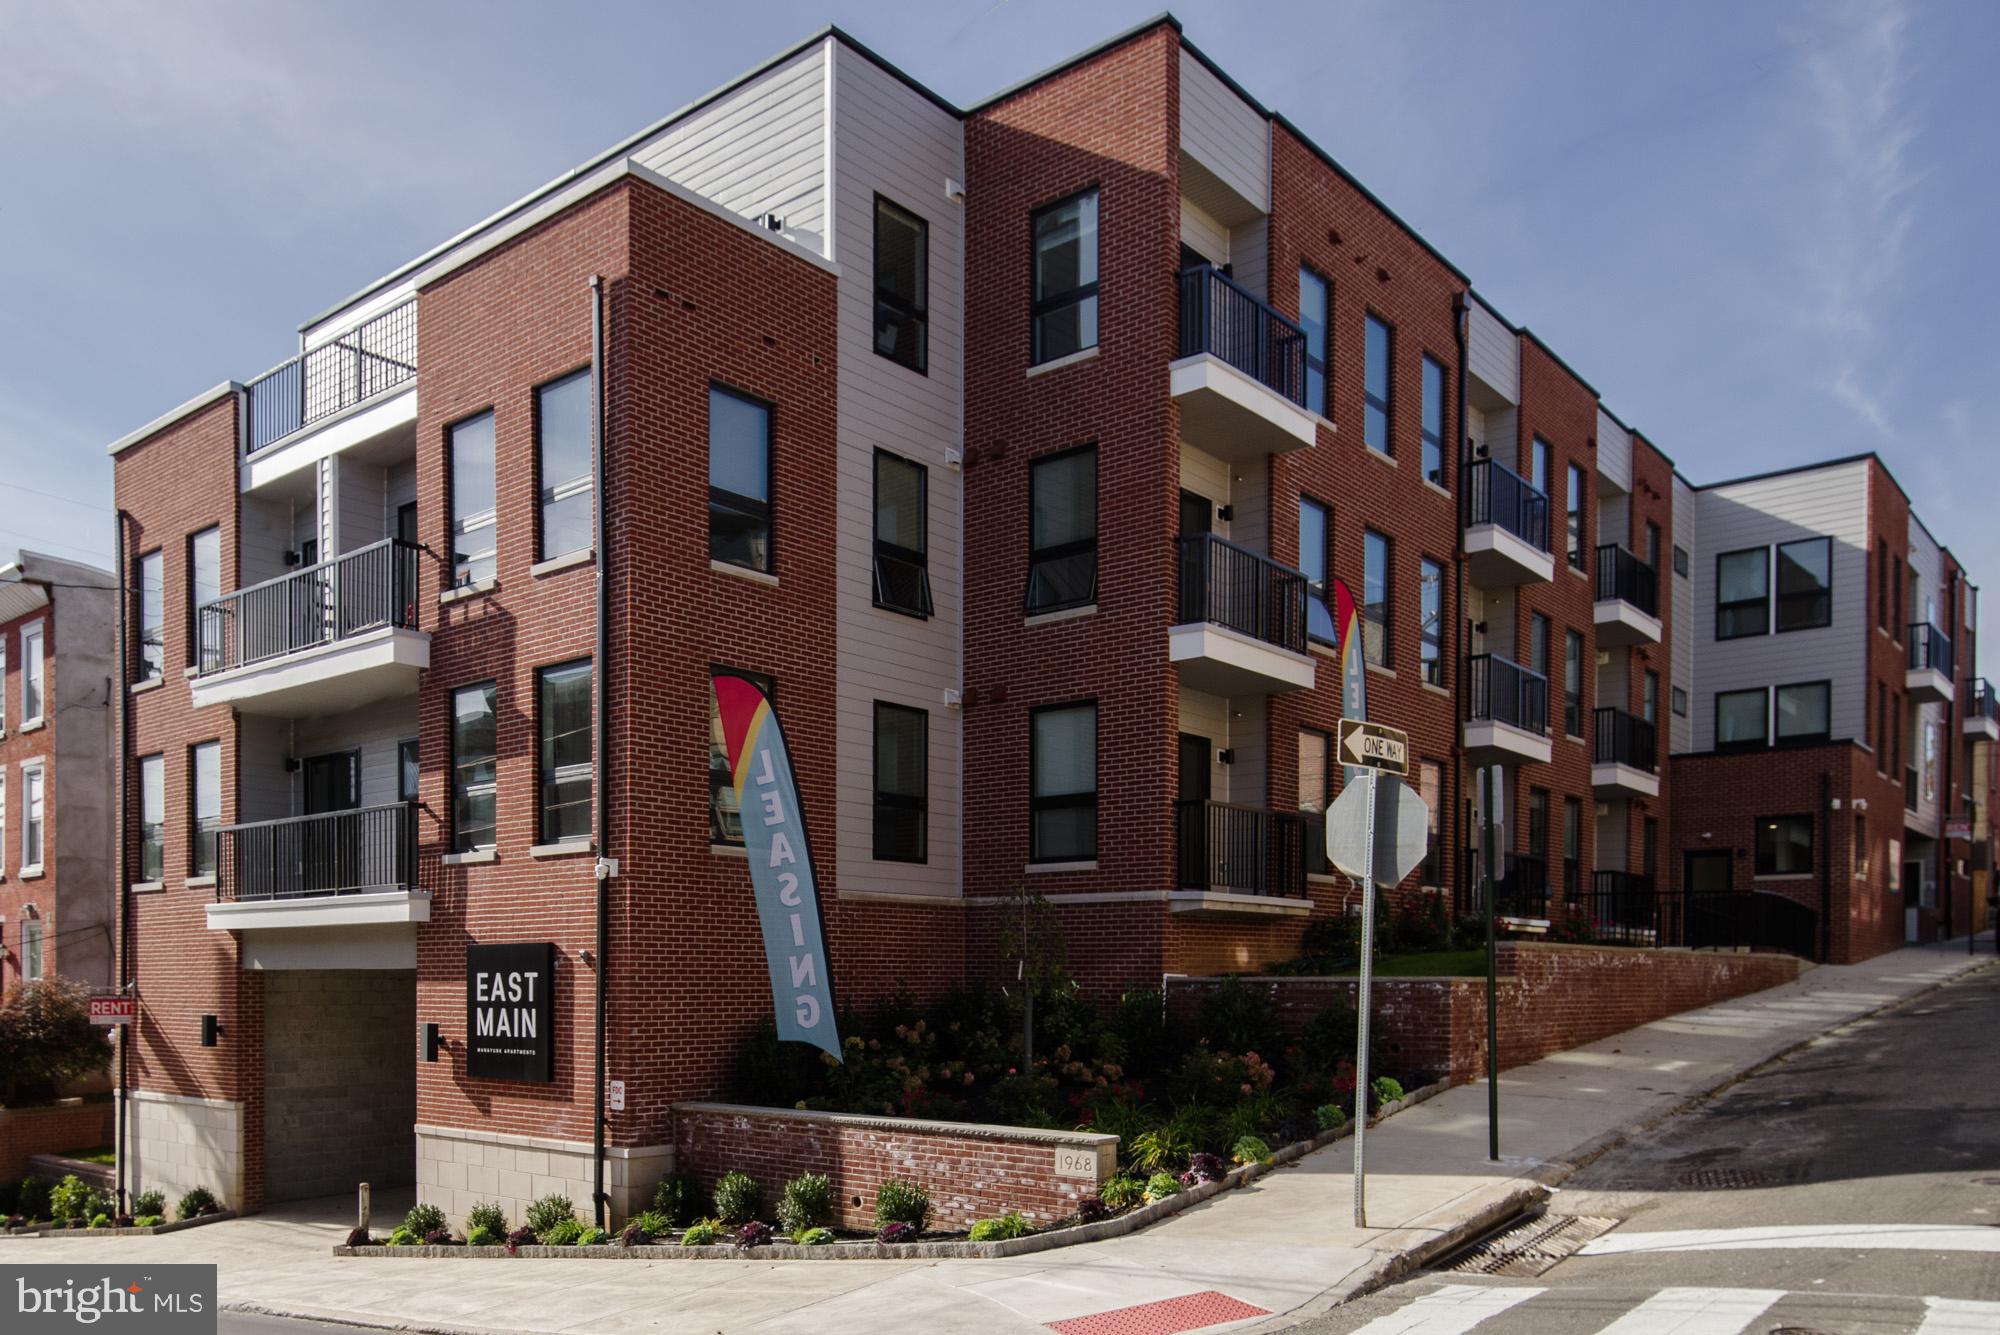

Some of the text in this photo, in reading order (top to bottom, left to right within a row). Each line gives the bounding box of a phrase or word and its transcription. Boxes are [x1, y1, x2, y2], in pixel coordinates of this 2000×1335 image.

[1364, 737, 1402, 761] ONE WAY
[476, 972, 539, 1002] EAST
[91, 1001, 130, 1014] RENT
[476, 1007, 537, 1038] MAIN
[1060, 1155, 1092, 1171] 1968
